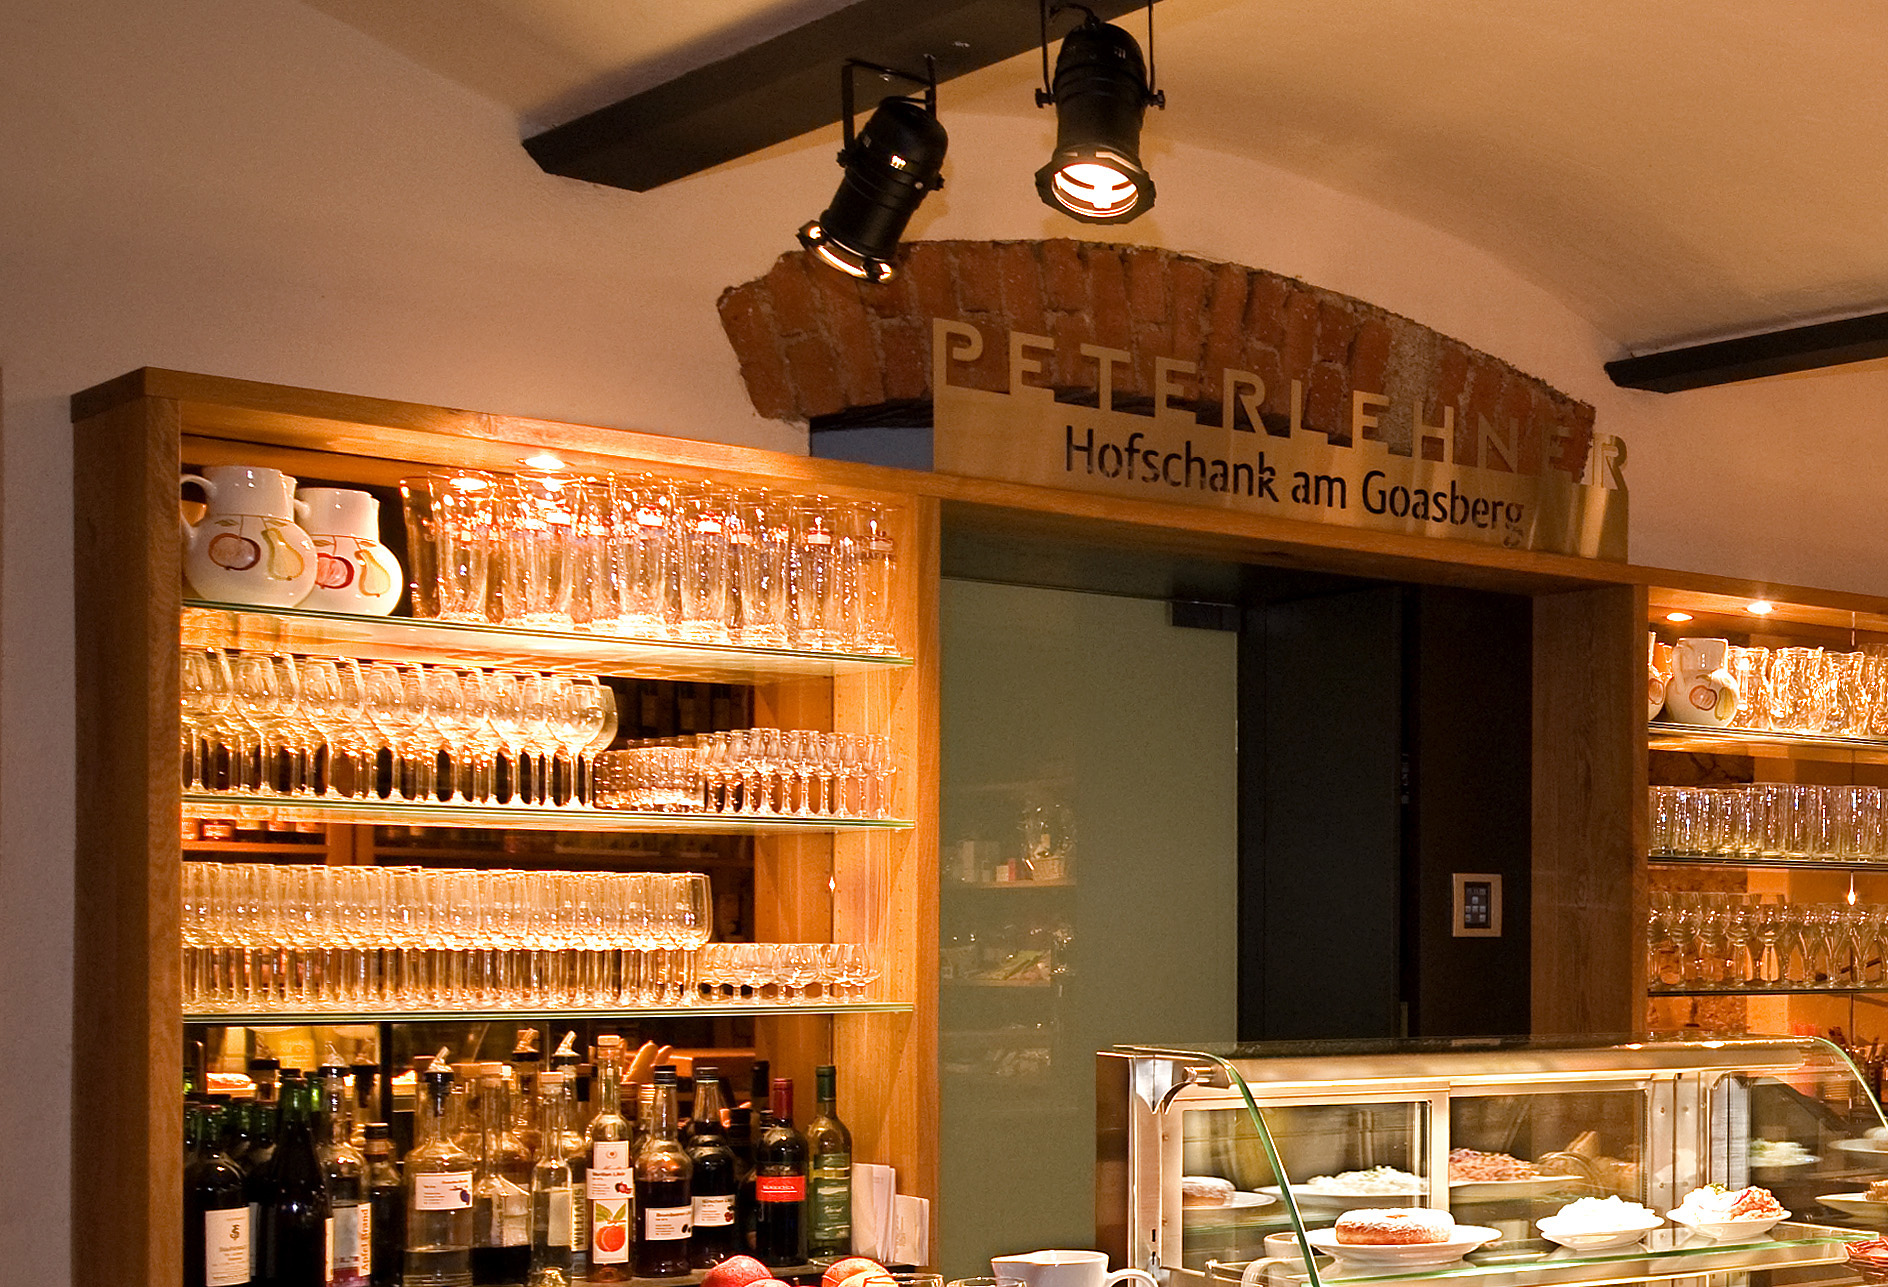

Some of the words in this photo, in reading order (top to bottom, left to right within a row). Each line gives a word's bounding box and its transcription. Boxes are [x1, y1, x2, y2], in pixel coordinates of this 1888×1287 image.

[932, 317, 1628, 490] PETERLEHNER
[1065, 424, 1279, 503] Hofschank
[1290, 470, 1347, 510] am
[1361, 469, 1524, 549] Goasberg
[360, 1208, 369, 1240] Brand
[573, 1188, 585, 1247] WILLIAMS
[360, 1242, 369, 1272] Apfel
